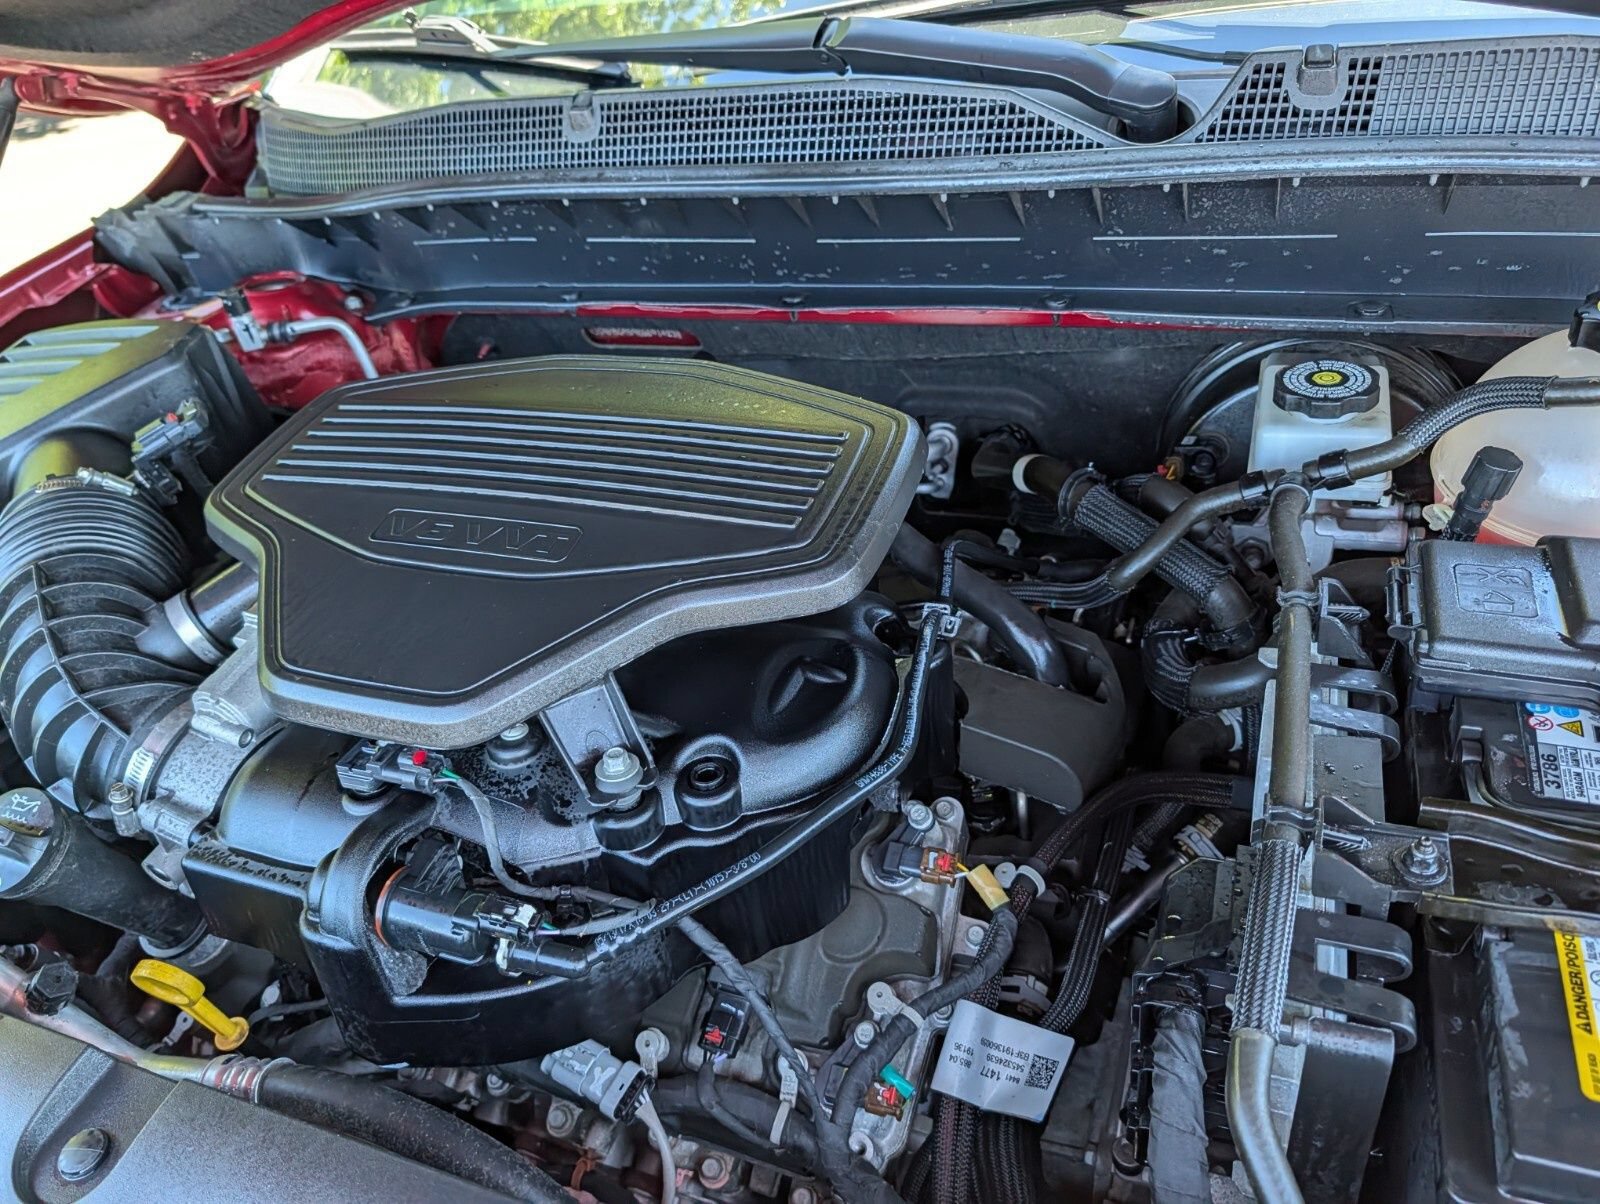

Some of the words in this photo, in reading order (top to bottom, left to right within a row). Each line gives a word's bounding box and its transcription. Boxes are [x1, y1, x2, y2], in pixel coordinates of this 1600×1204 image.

[1541, 753, 1561, 790] 3786
[1562, 932, 1593, 1024] DANGER/POISO
[953, 1042, 974, 1057] 19136
[949, 1053, 972, 1069] 865.04
[986, 1052, 1026, 1073] 545324639
[980, 1065, 1000, 1081] 1477
